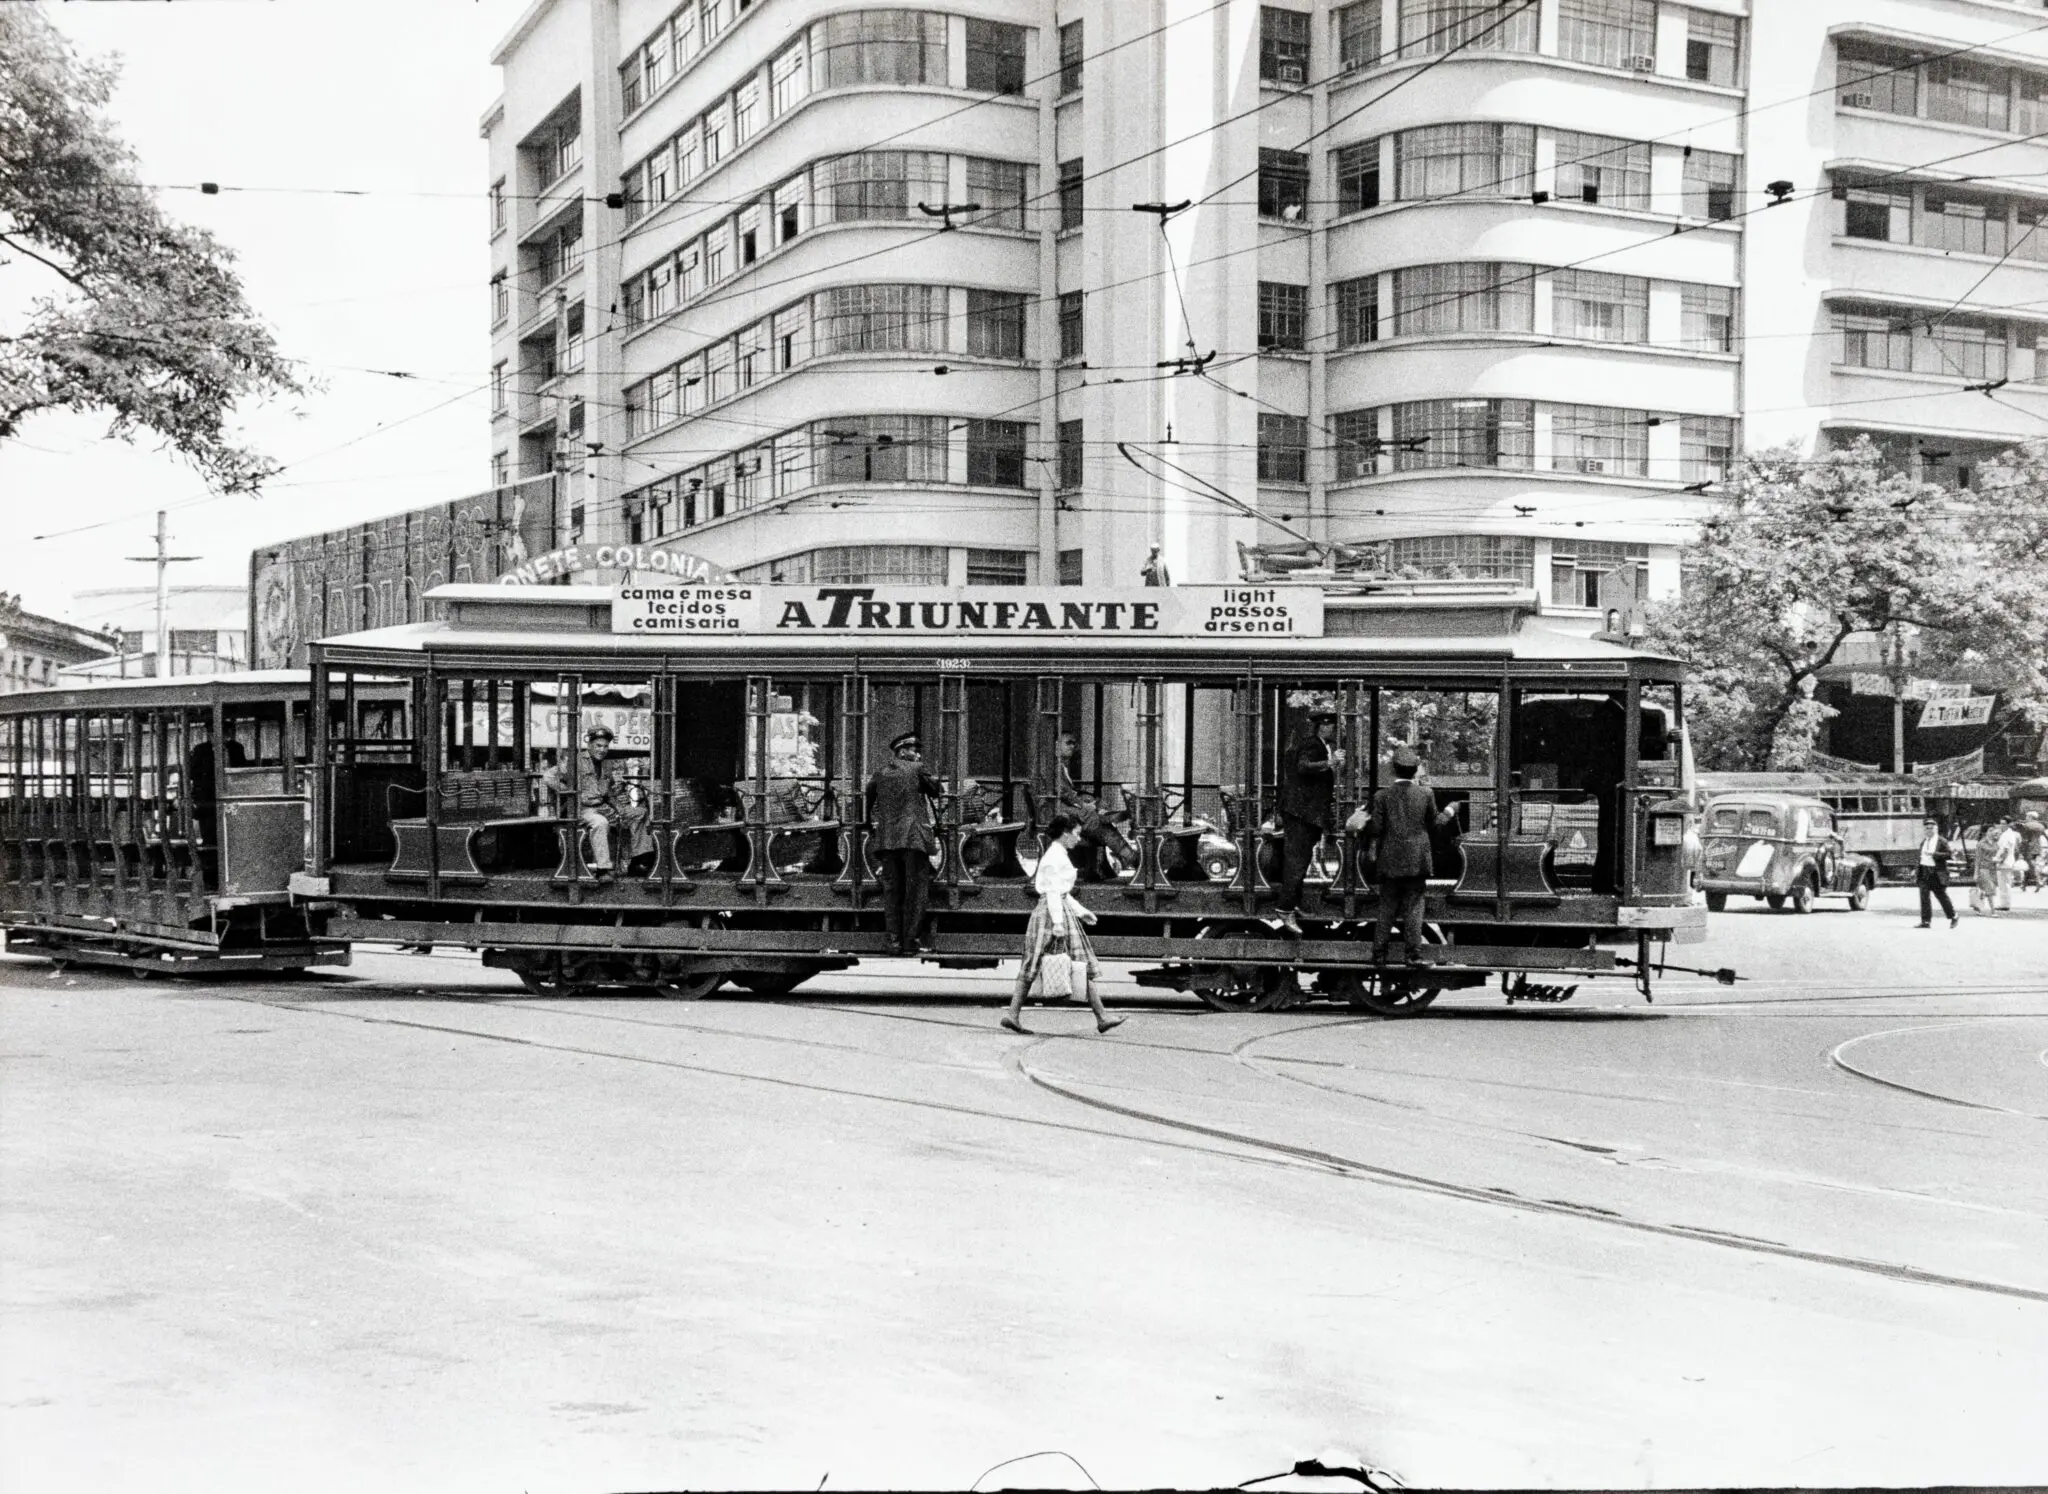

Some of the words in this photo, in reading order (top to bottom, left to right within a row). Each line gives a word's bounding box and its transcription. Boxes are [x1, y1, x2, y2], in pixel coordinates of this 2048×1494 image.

[596, 546, 710, 583] COLONIA
[621, 589, 674, 600] cama
[680, 589, 691, 600] e
[697, 589, 752, 600] mesa
[1224, 589, 1276, 606] light
[648, 601, 726, 614] tecidos
[1211, 606, 1288, 620] passos
[633, 615, 740, 629] camisaria
[1205, 618, 1293, 632] arsenal
